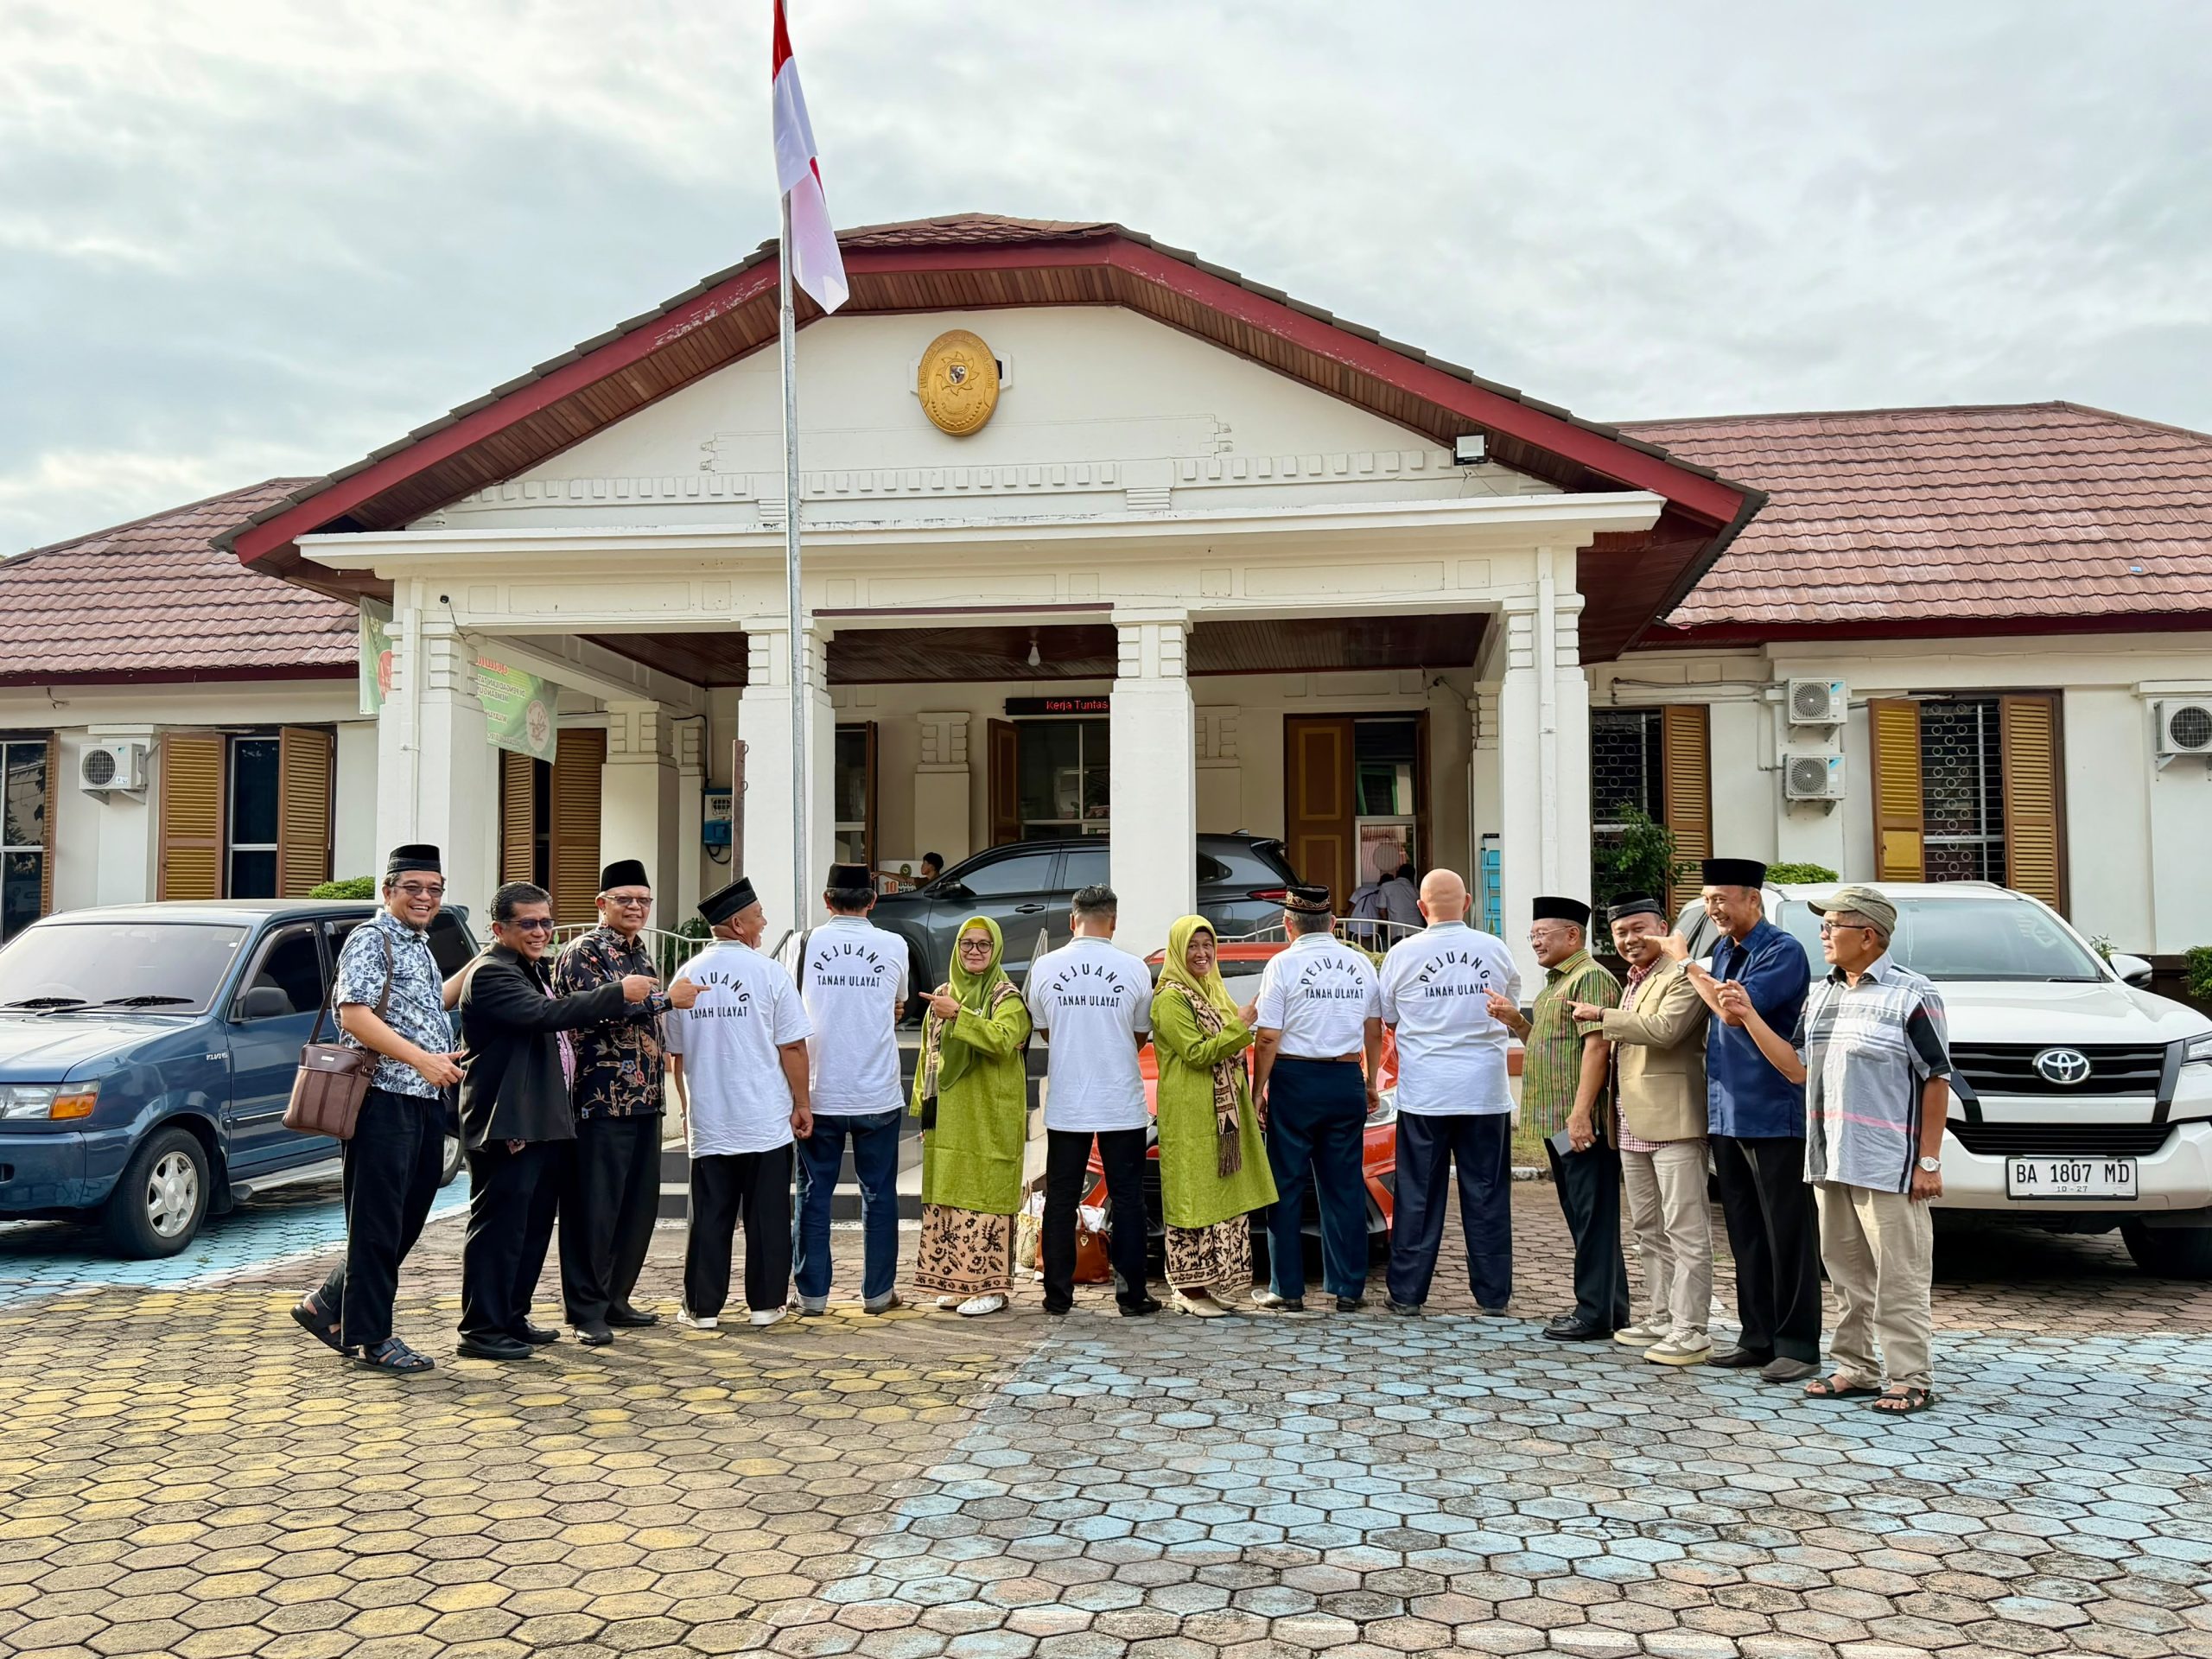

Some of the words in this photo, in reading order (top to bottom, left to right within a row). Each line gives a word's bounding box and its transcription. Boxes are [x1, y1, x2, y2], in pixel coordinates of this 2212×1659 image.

[1046, 700, 1072, 710] Kerja
[1074, 700, 1108, 709] Tuntas
[885, 880, 897, 893] 10
[813, 943, 886, 974] PEJUANG
[1420, 951, 1491, 983] PEJUANG
[817, 975, 845, 987] TANAH
[849, 976, 880, 988] ULAYAT
[1052, 963, 1125, 994] PEJUANG
[700, 971, 751, 1002] JUANG
[1425, 985, 1454, 998] TANAH
[1306, 988, 1332, 1000] TANAH
[1335, 988, 1363, 1000] ULAYAT
[1058, 995, 1086, 1007] TANAH
[1090, 995, 1120, 1008] ULAYAT
[717, 1006, 748, 1018] ULAYAT
[2017, 1164, 2037, 1183] BA
[2050, 1163, 2092, 1183] 1807
[2105, 1163, 2130, 1183] MD
